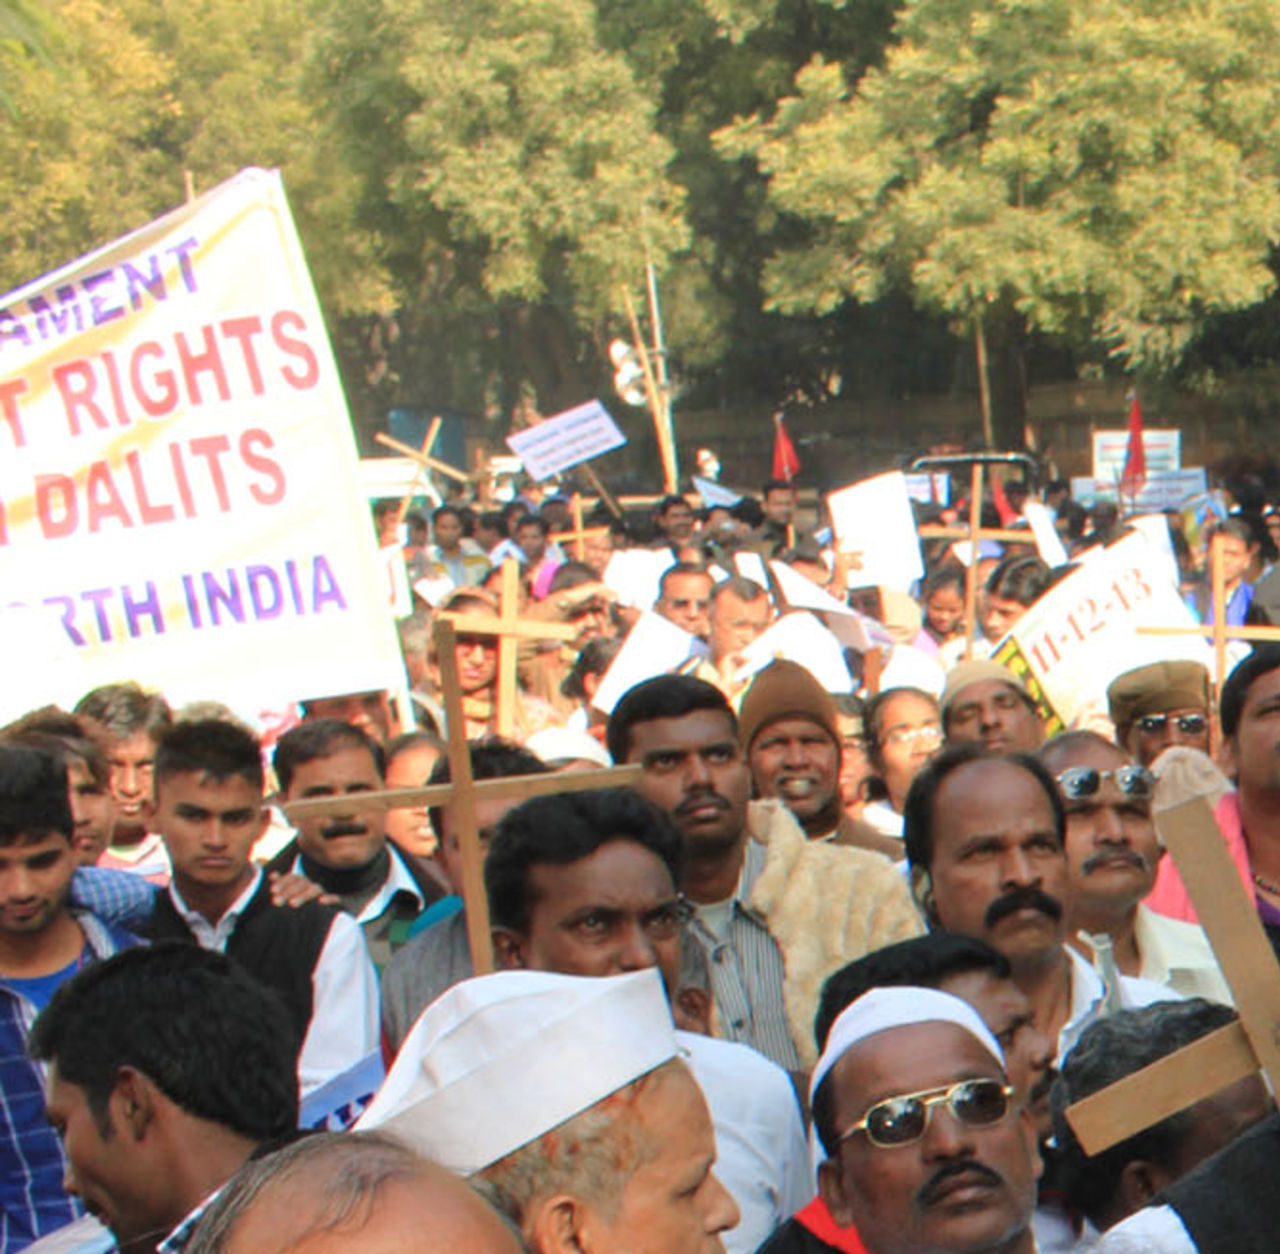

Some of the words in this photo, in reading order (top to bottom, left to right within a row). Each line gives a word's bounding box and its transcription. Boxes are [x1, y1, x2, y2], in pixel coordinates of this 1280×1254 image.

[52, 310, 320, 436] RIGHTS
[34, 428, 286, 540] DALITS
[182, 555, 348, 630] INDIA
[1032, 567, 1153, 673] 11-12-13
